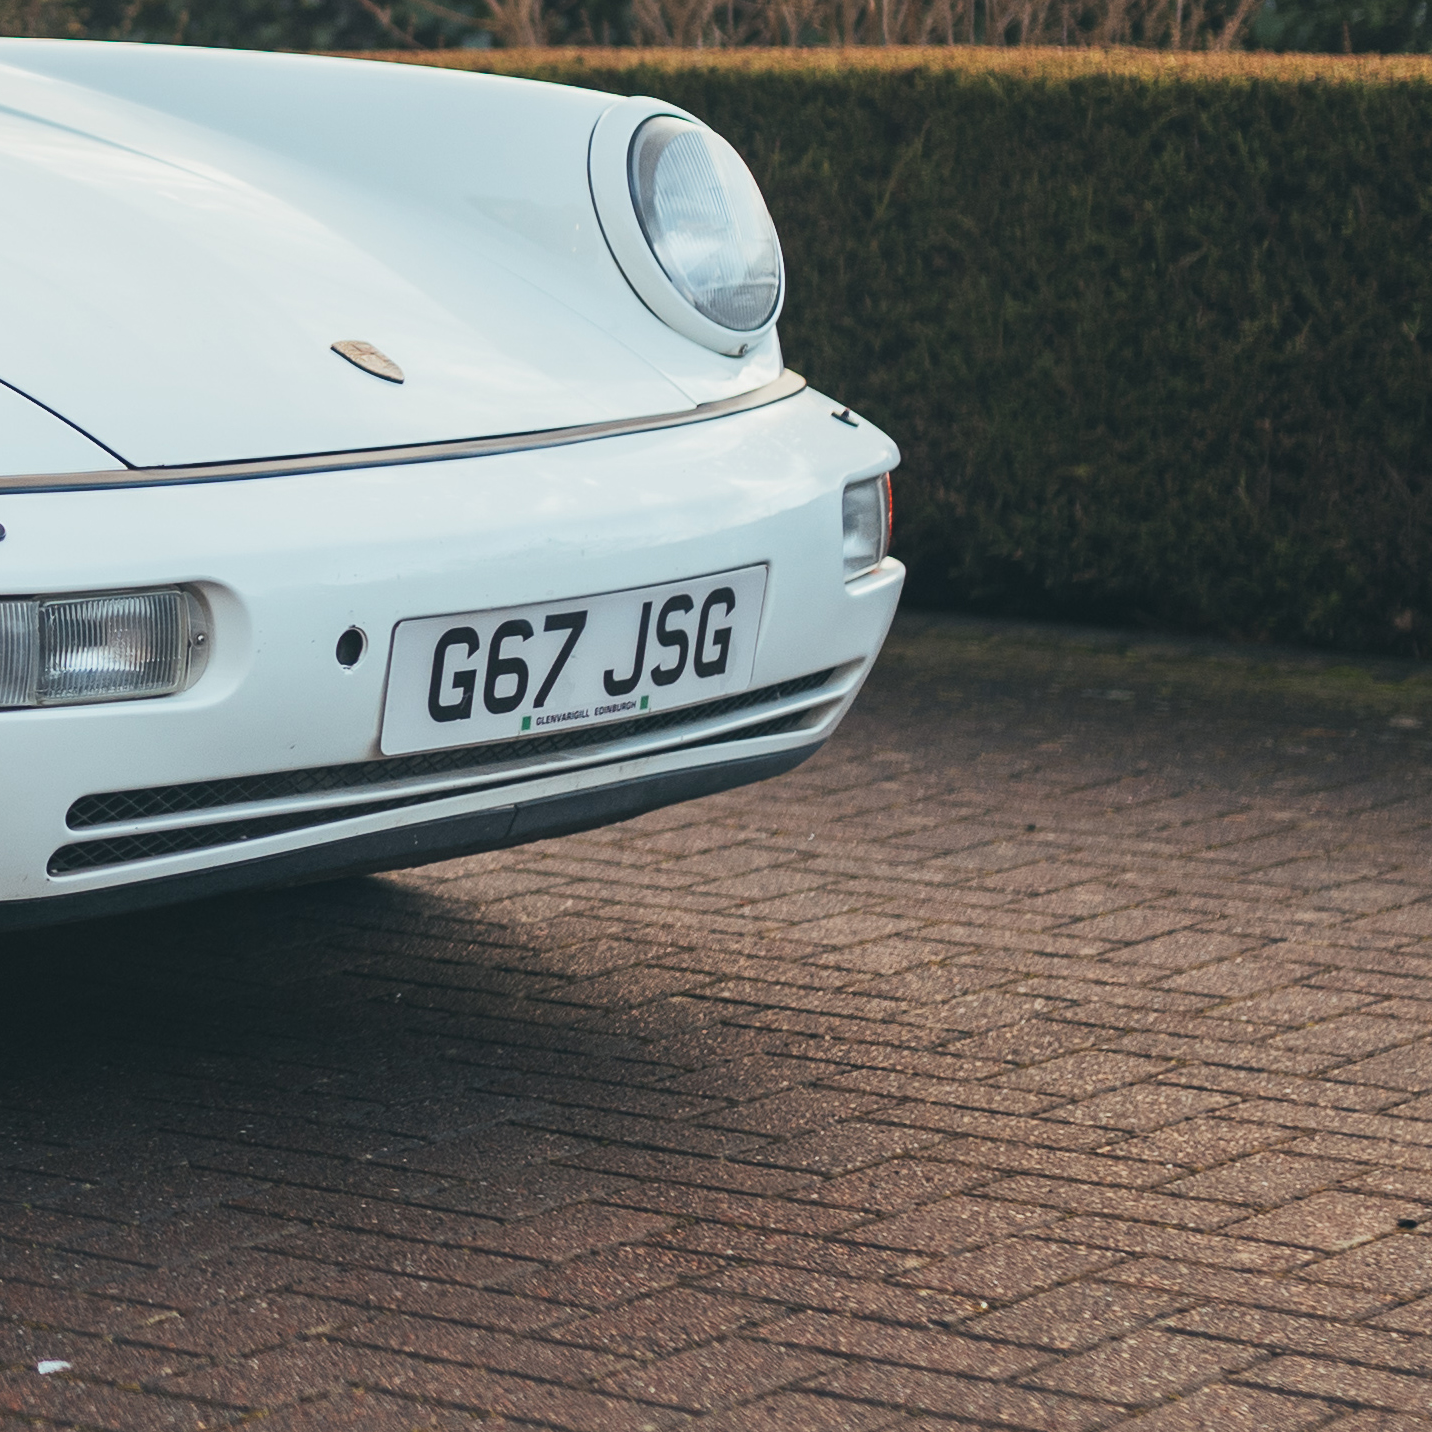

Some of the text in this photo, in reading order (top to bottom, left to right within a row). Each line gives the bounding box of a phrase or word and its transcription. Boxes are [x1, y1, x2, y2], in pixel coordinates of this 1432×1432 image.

[428, 586, 736, 723] G67 JSG
[535, 700, 637, 726] GLENVARIGILL EDINBURGH
